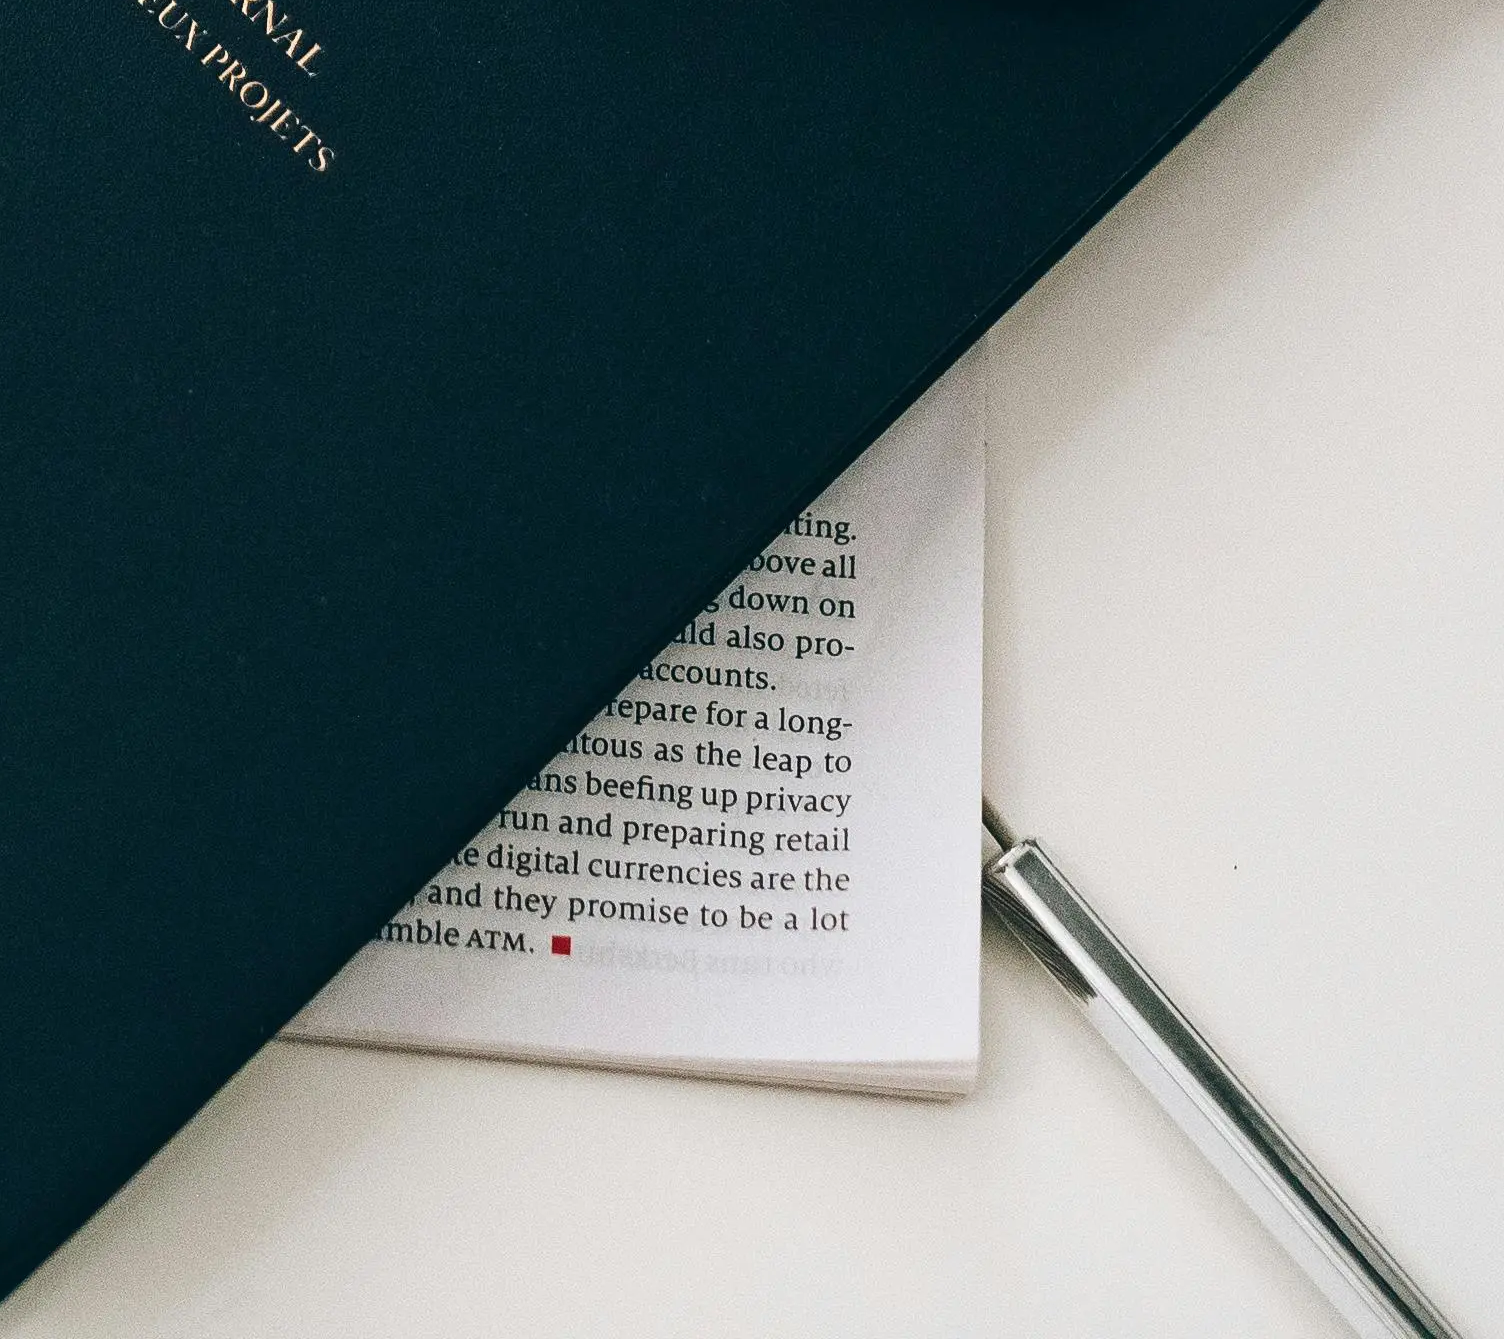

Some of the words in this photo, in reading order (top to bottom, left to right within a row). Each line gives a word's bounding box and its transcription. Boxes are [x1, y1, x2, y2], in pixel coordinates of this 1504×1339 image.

[201, 43, 336, 173] PROJETS
[820, 553, 856, 580] all
[727, 583, 810, 615] down
[817, 596, 855, 619] on
[724, 623, 785, 652] also
[794, 634, 855, 660] pro-
[705, 699, 748, 728] for
[753, 710, 769, 731] a
[777, 705, 853, 742] long-
[652, 741, 684, 763] as
[694, 739, 742, 768] the
[752, 743, 813, 779] leap
[823, 751, 852, 774] to
[584, 769, 693, 811] beefing
[700, 785, 738, 813] up
[744, 785, 852, 818] privacy
[557, 811, 612, 838] and
[621, 819, 765, 856] preparing
[774, 826, 849, 852] retail
[485, 842, 579, 878] digital
[586, 857, 742, 889] currencies
[749, 870, 796, 891] are
[803, 866, 850, 892] the
[426, 881, 482, 908] and
[493, 884, 558, 920] they
[567, 896, 689, 926] promise
[699, 904, 728, 928] to
[739, 903, 773, 930] be
[783, 911, 798, 931] a
[811, 906, 847, 932] lot
[464, 927, 534, 954] ATM.
